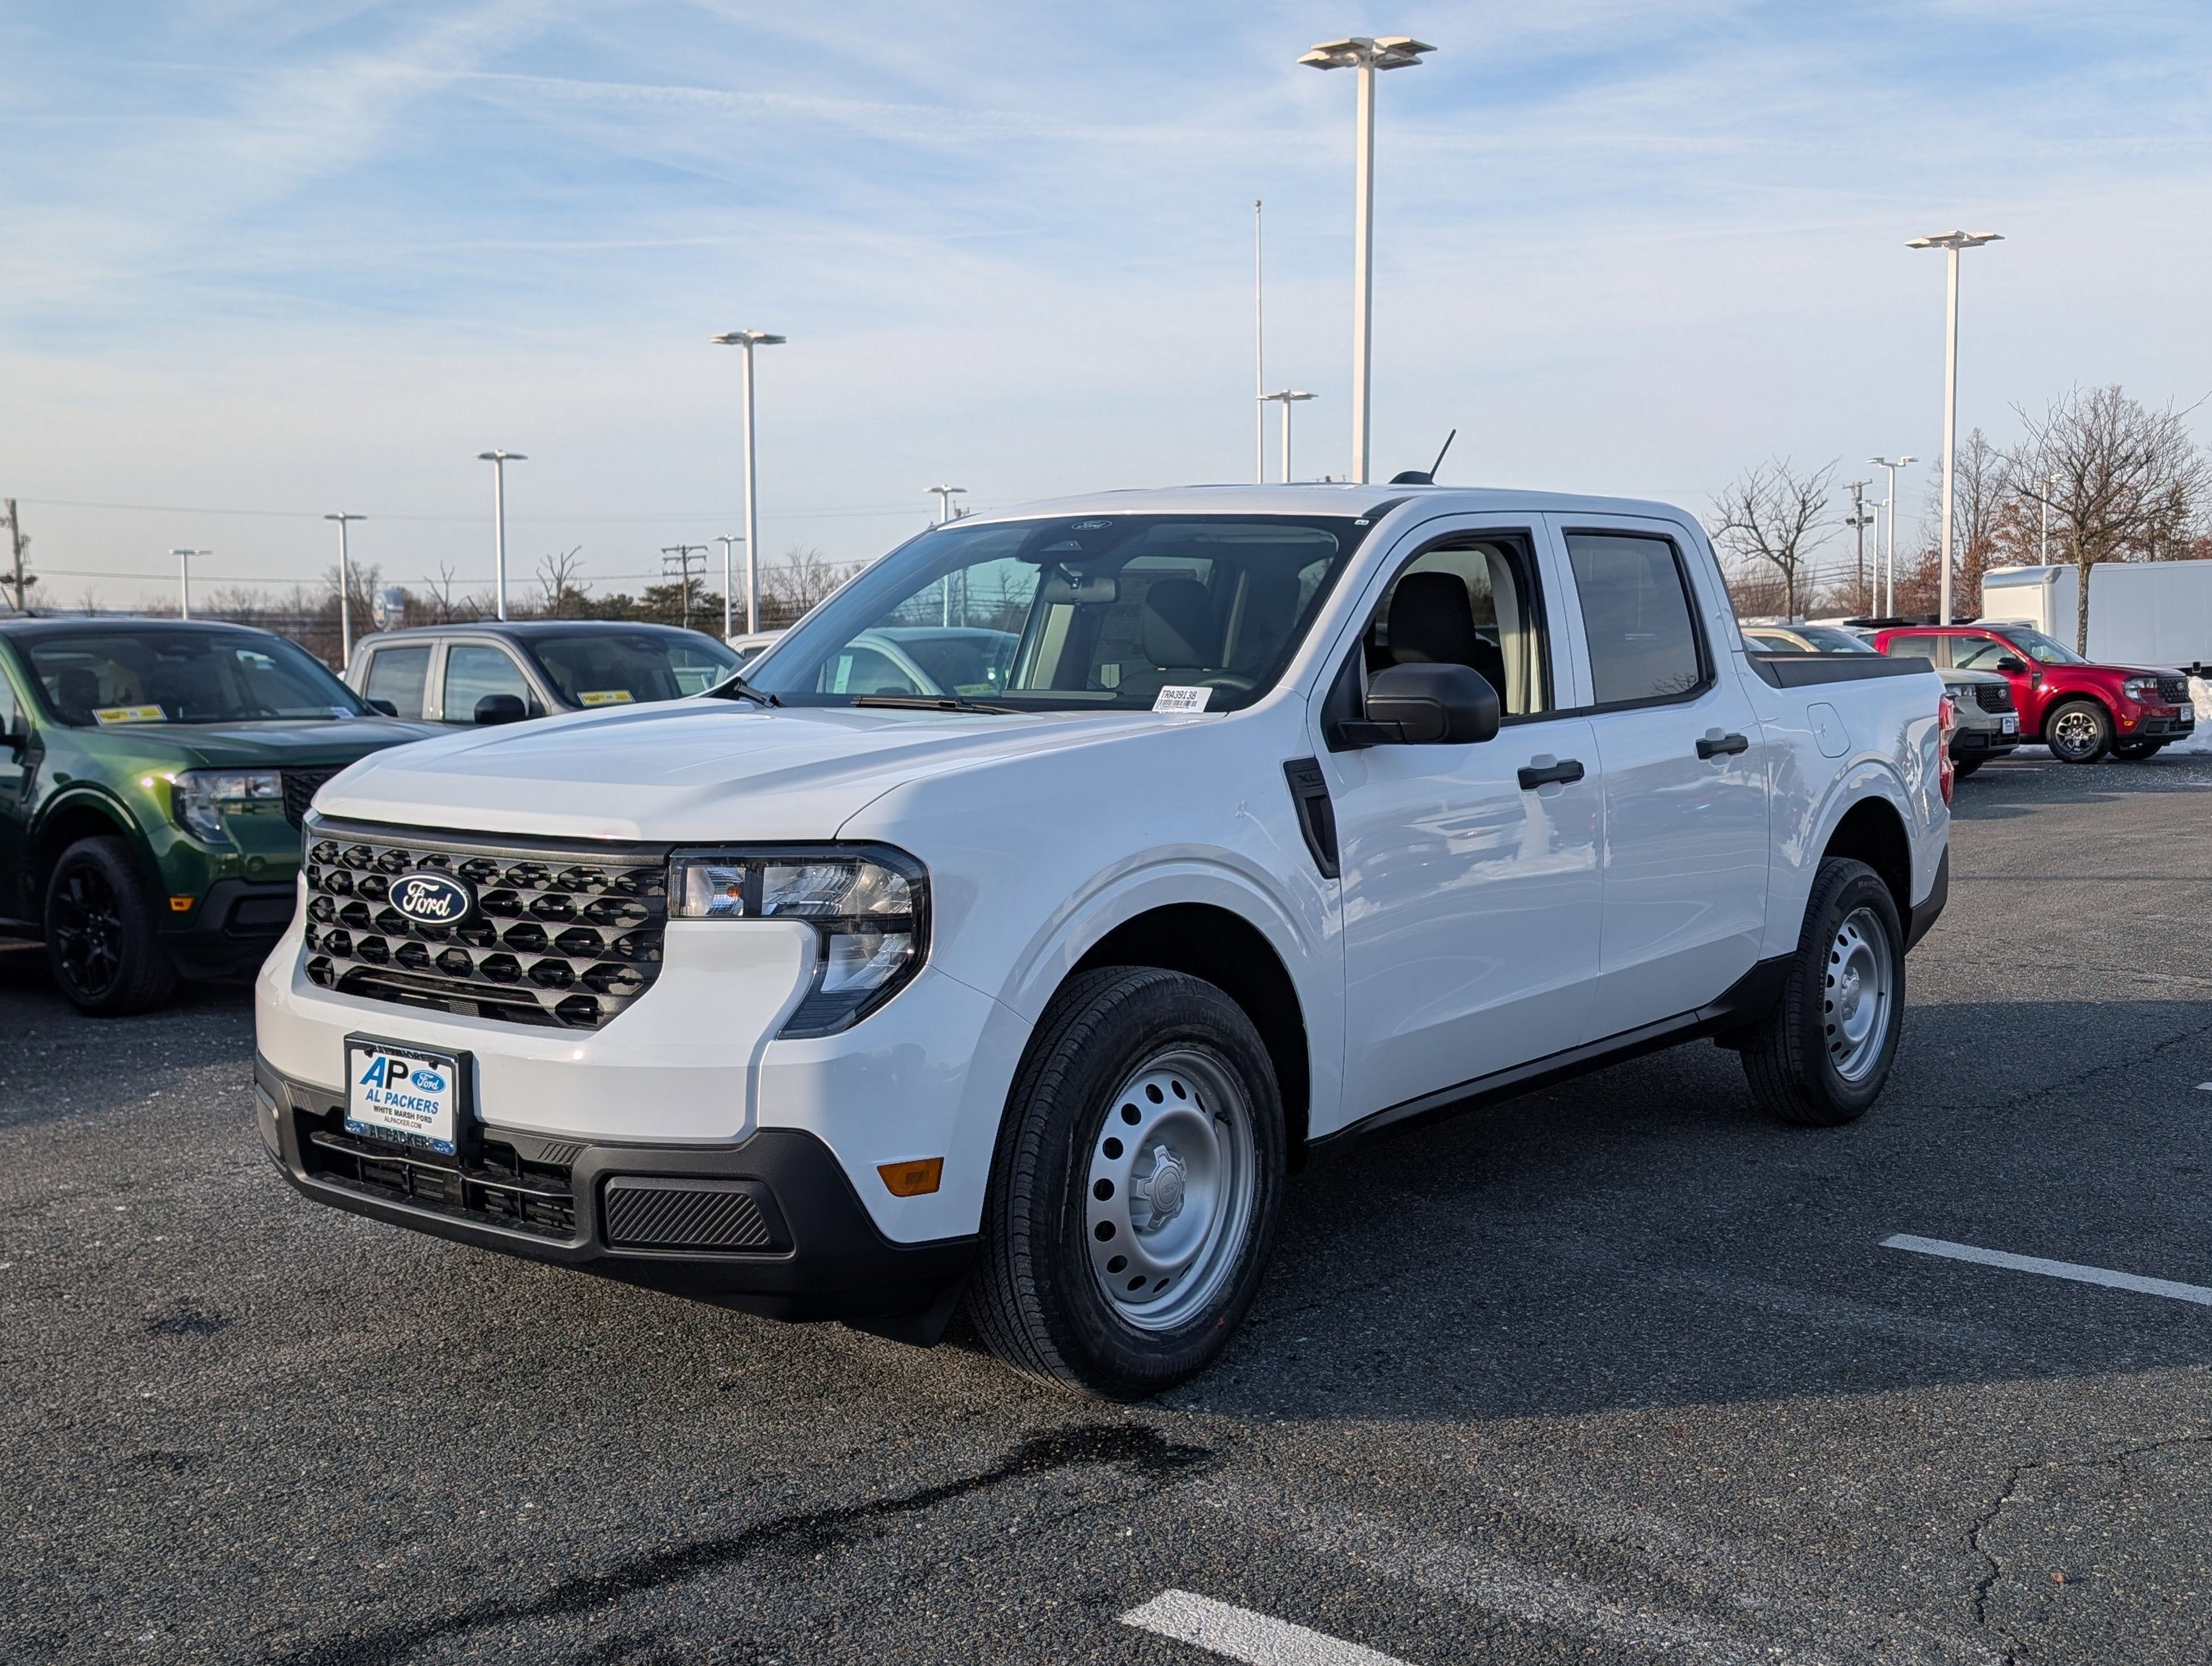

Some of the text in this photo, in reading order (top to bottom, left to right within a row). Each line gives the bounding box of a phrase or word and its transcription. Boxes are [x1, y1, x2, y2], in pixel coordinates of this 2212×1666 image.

[1161, 690, 1197, 700] TRA39138
[403, 880, 452, 917] Ford
[359, 1056, 439, 1091] AP Ford
[365, 1088, 439, 1115] AL PACKERS
[373, 1105, 432, 1124] WHITE MARSH FORD
